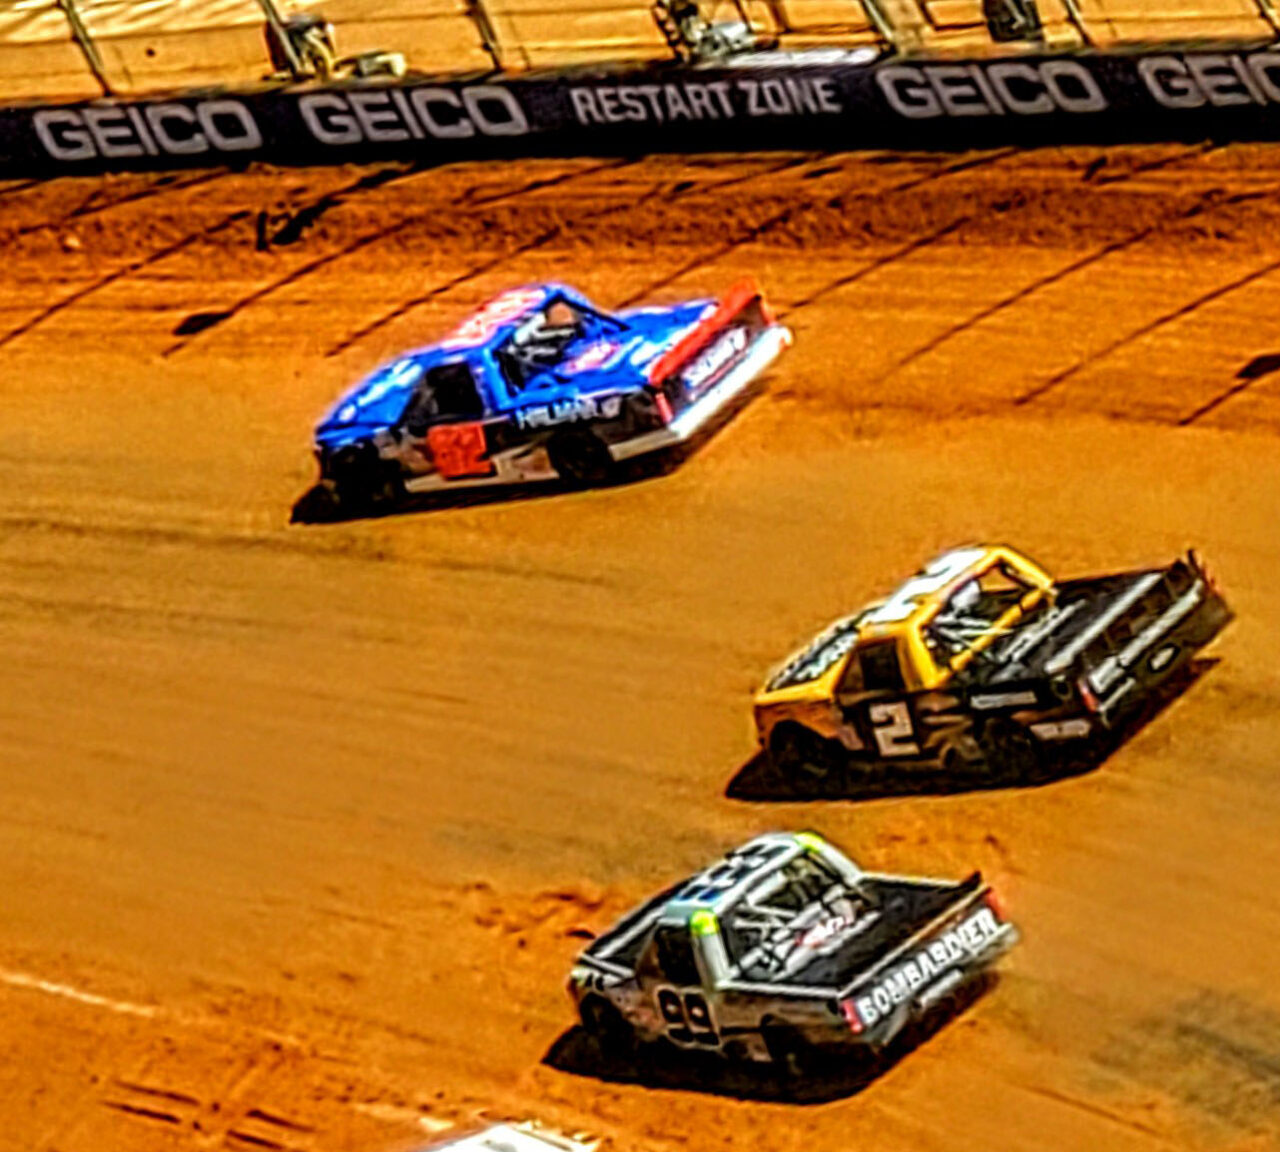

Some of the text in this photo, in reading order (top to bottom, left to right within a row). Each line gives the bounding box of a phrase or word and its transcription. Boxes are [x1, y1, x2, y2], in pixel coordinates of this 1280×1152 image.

[300, 86, 529, 144] GEICO
[573, 77, 843, 126] RESTART ZONE
[876, 60, 1108, 119] GEICO
[34, 98, 262, 161] GEICO
[869, 701, 920, 757] 2
[855, 907, 1000, 1027] BOMBARDIER
[654, 985, 721, 1050] 99
